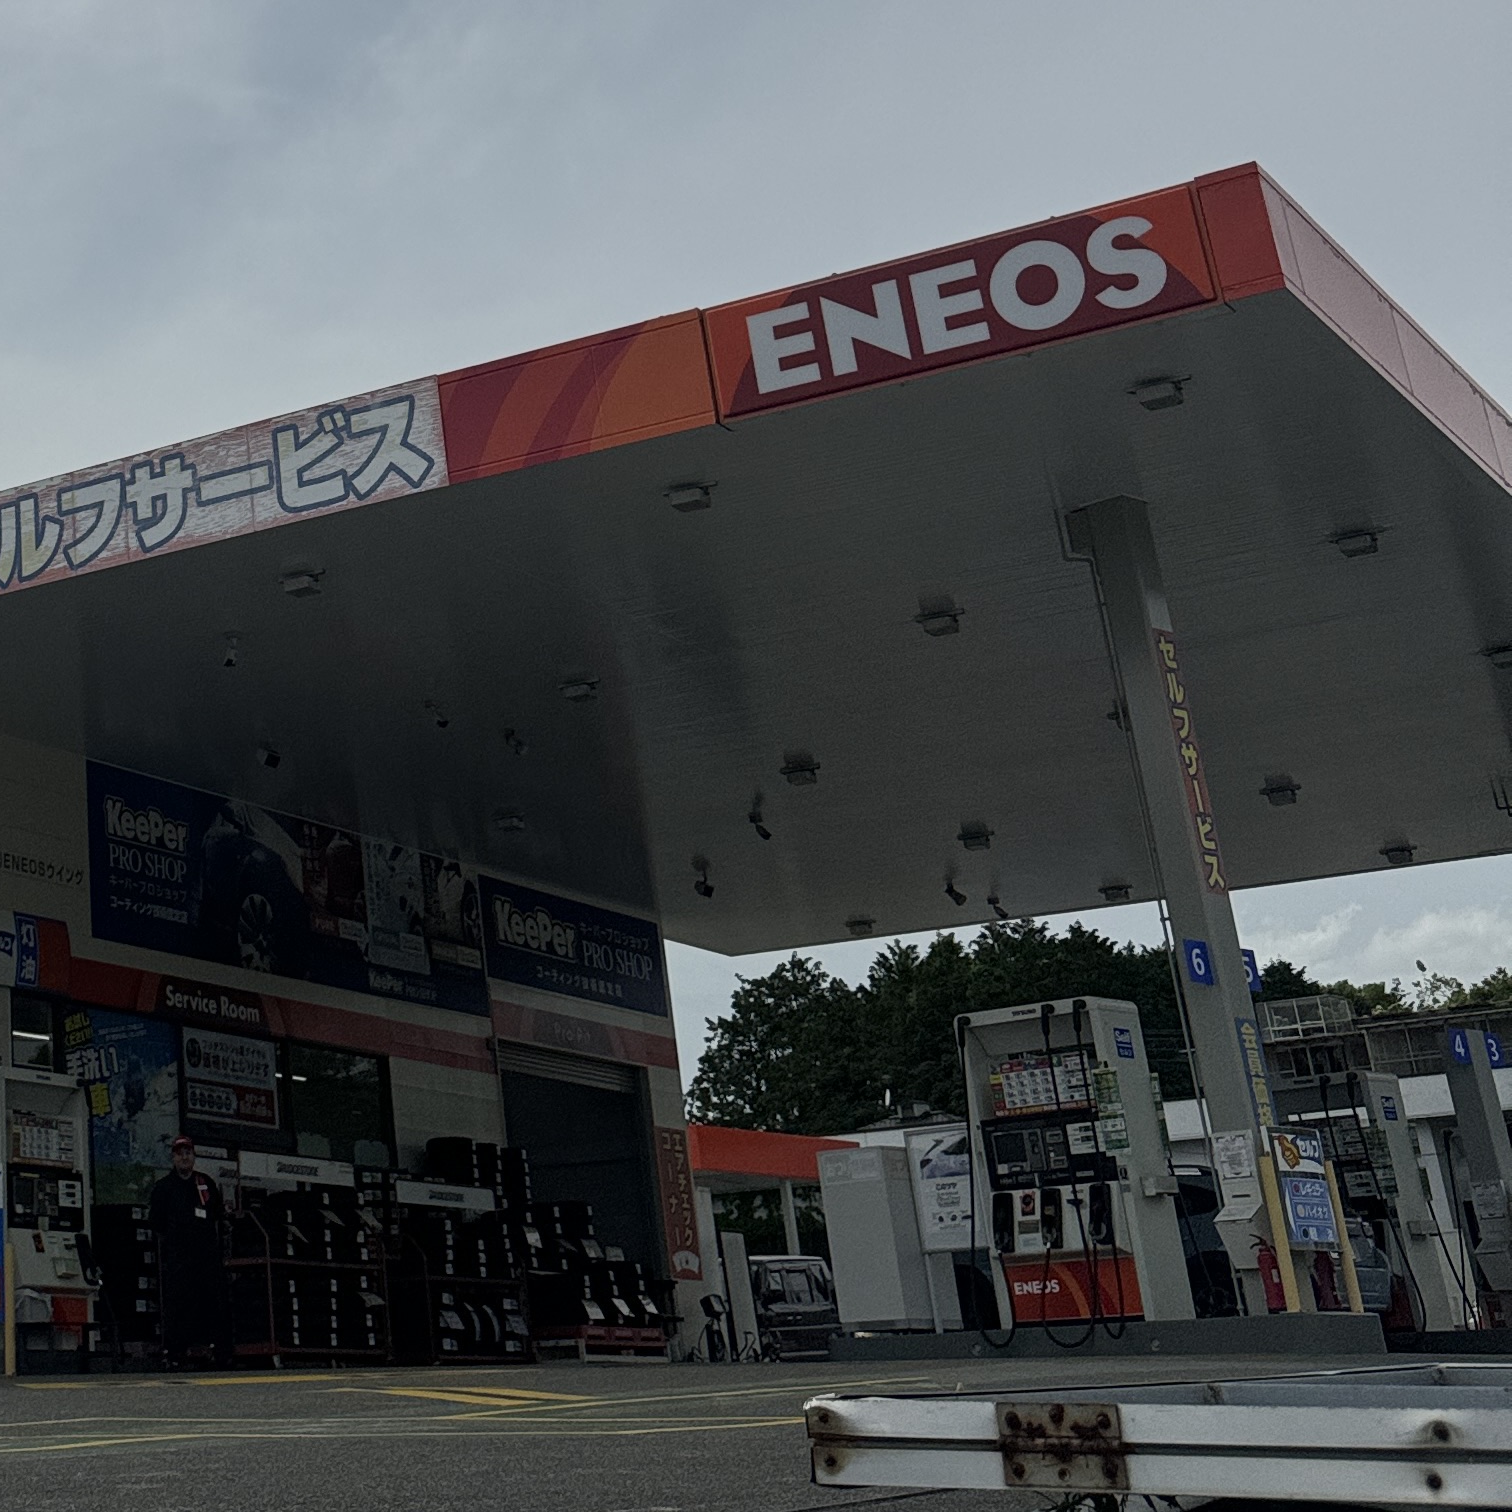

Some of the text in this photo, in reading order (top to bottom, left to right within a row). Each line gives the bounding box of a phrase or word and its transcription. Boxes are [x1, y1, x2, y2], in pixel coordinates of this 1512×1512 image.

[746, 215, 1169, 395] ENEOS
[1158, 635, 1226, 890] セルフサービス
[105, 796, 189, 853] KeePer
[109, 843, 187, 884] PRO SHOP
[494, 896, 576, 961] KeePer
[20, 922, 36, 986] 灯油
[582, 940, 652, 982] PRO SHOP
[1192, 948, 1205, 976] 6
[1242, 956, 1254, 984] 5
[165, 985, 260, 1024] Service Room
[65, 1046, 120, 1080] 手洗い
[1454, 1034, 1465, 1057] 4
[1487, 1038, 1500, 1062] 3
[1296, 1138, 1319, 1158] セルフ
[661, 1132, 681, 1247] コーナー
[672, 1133, 693, 1248] エアチェック
[1305, 1204, 1328, 1218] ハイオク
[1014, 1279, 1060, 1295] ENEOS
